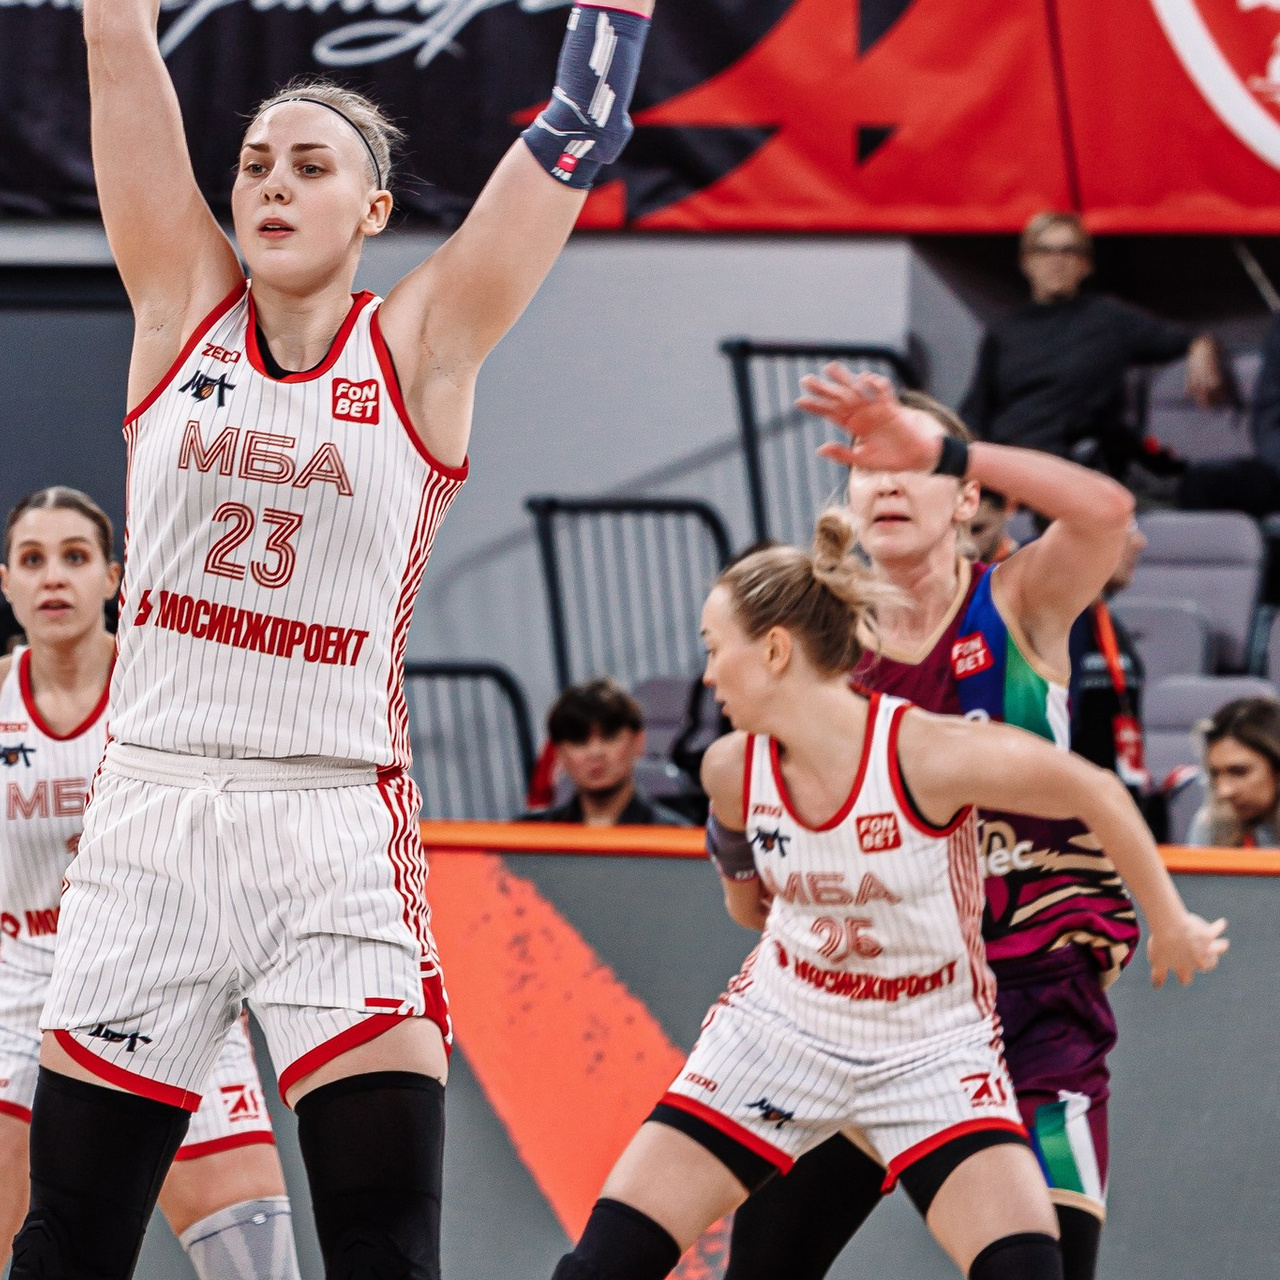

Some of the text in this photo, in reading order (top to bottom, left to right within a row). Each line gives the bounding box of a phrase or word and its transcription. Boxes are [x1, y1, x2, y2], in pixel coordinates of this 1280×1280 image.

[334, 400, 378, 419] BET
[335, 381, 377, 401] FON
[178, 420, 354, 496] МБА
[204, 501, 303, 589] 23
[155, 589, 369, 665] МОСИНЖПРОЕКТ
[6, 777, 88, 821] МБ
[811, 916, 883, 964] 25
